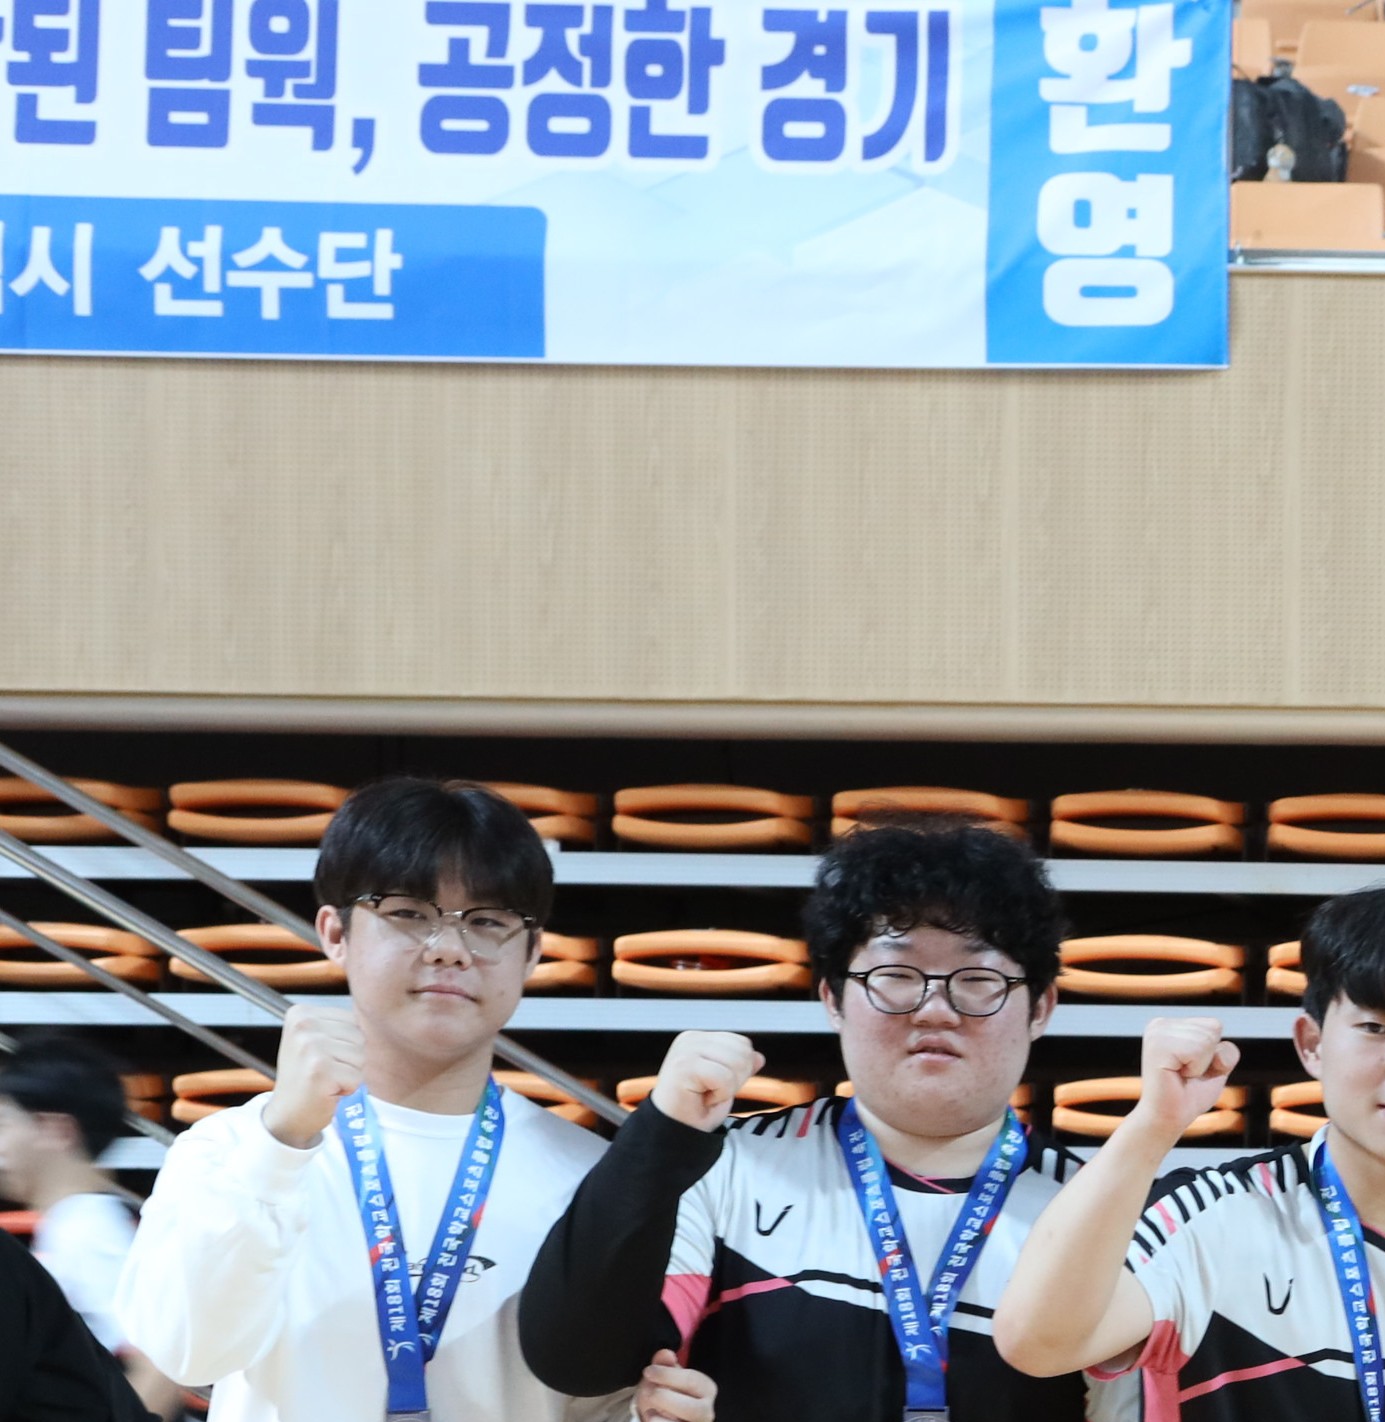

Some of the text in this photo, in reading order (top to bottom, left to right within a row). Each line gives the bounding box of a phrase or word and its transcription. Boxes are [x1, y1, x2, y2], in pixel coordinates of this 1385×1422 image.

[0, 0, 950, 176] 된 팀웍, 공정한 경기
[1036, 0, 1192, 327] 환영
[0, 221, 404, 320] 시 선수단
